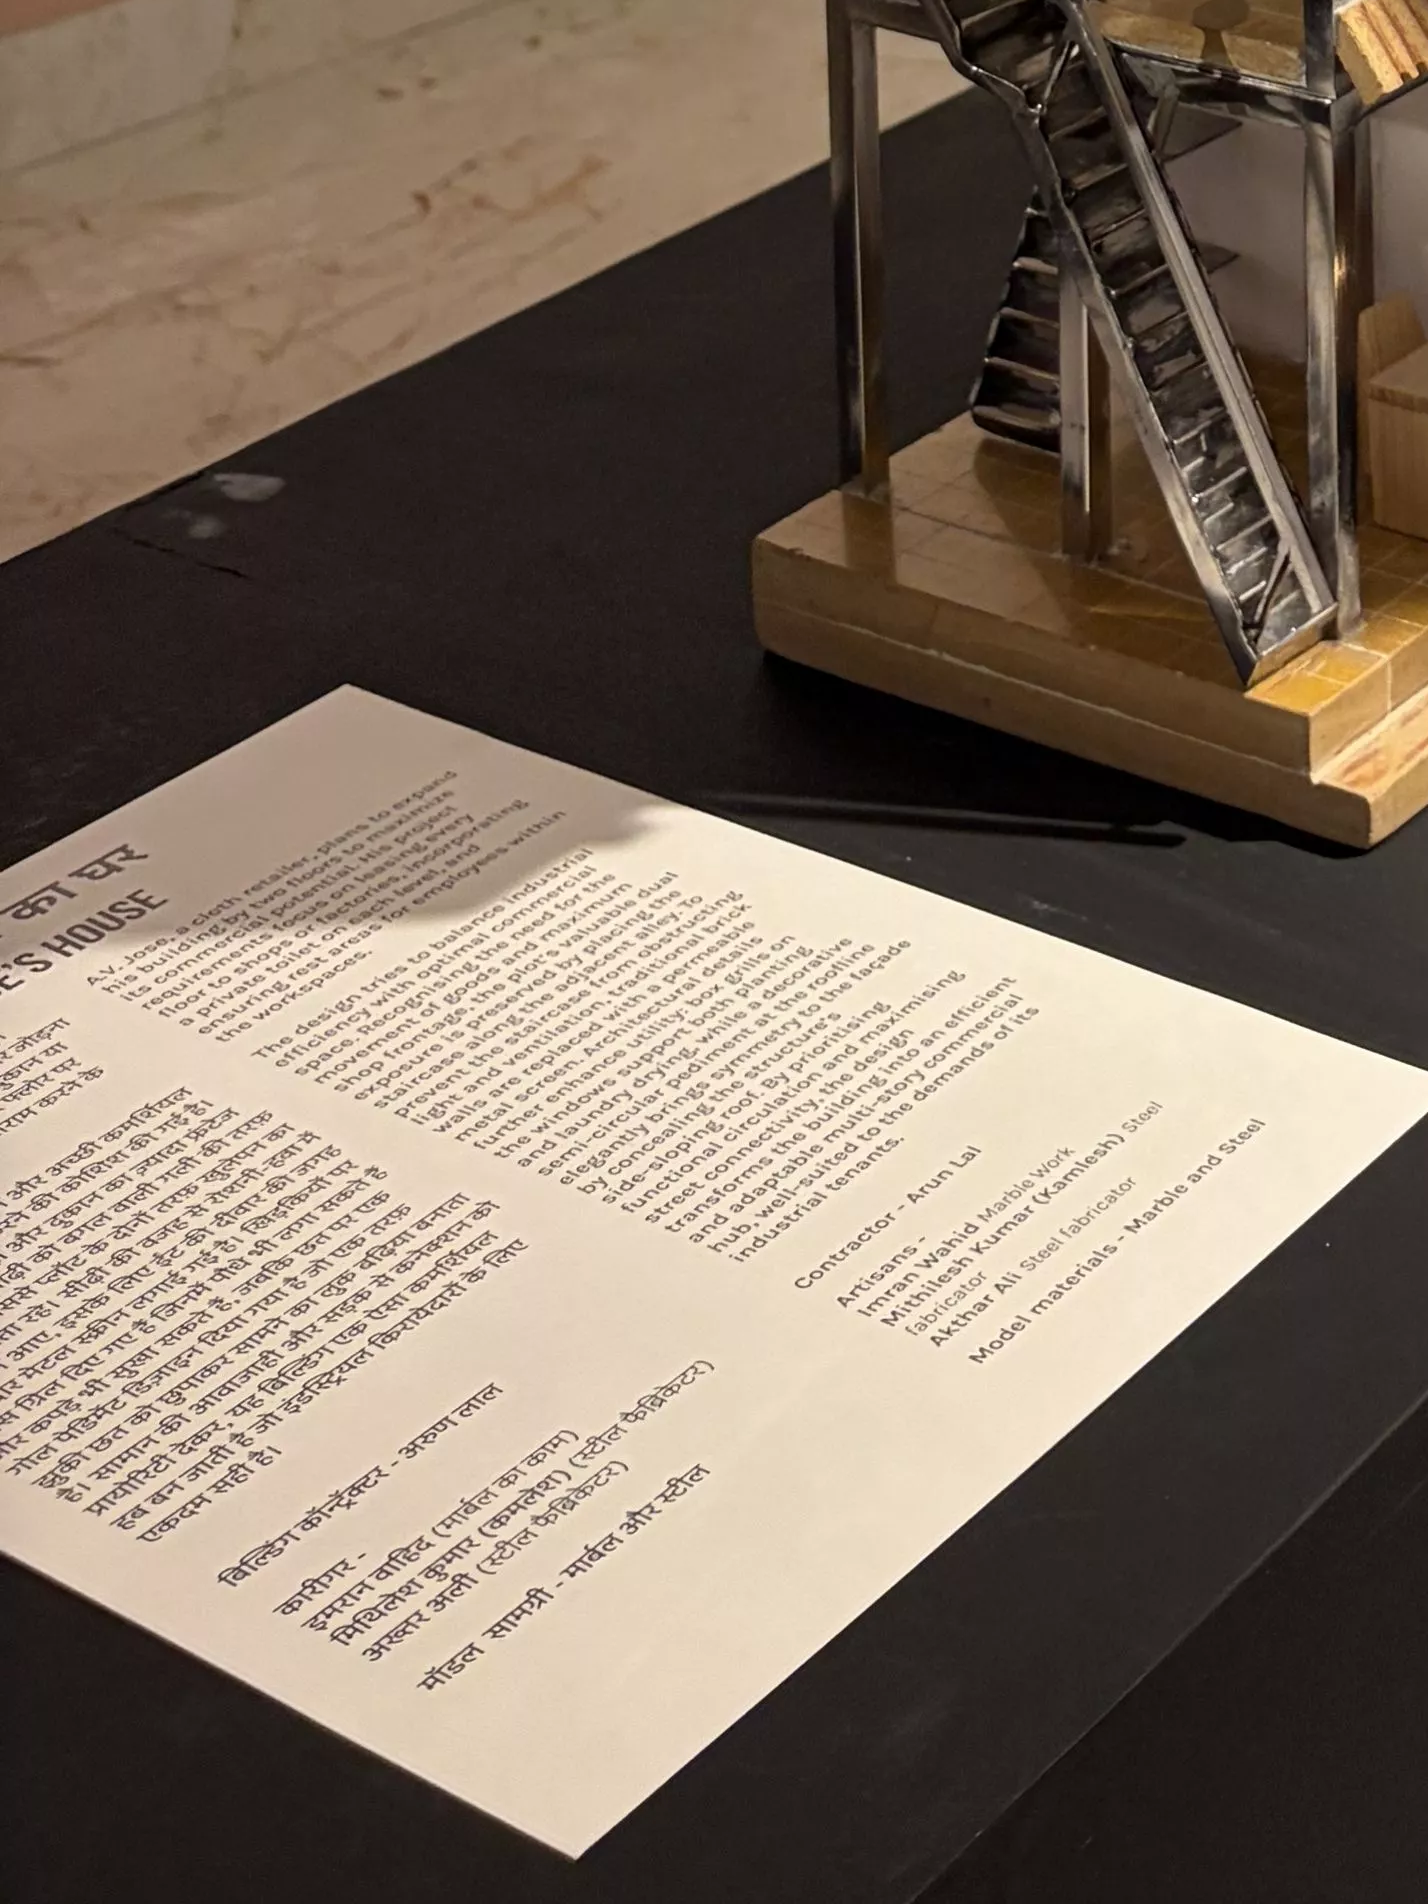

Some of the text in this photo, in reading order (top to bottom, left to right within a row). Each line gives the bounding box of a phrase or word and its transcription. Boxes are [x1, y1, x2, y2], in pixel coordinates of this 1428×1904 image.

[40, 888, 169, 958] HOUSE
[67, 843, 149, 881] घर
[249, 847, 593, 1058] The design tries to balance industrial
[559, 939, 911, 1185] elegantly brings symmetry to the façade
[575, 1011, 841, 1195] by concealing the structure's
[601, 1000, 891, 1204] side-sloping roof. By prioritising
[619, 969, 966, 1213] functional circulation and maximising
[644, 1028, 915, 1224] street connectivity, the design
[663, 976, 1017, 1233] transforms the building into an efficient
[687, 992, 1023, 1244] and adaptable multi-story commercial
[705, 1006, 1040, 1253] hub, well-suited to the demands of its
[727, 1136, 905, 1262] industrial tenants.
[793, 1211, 896, 1289] Contractor
[905, 1168, 954, 1204] Arun
[947, 1144, 982, 1168] Lal
[836, 1244, 918, 1308] Artisans
[855, 1146, 1076, 1317] Imran Wahid Marble Work
[879, 1099, 1163, 1327] Mithilesh Kumar (Kamlesh) Steel
[929, 1176, 1136, 1348] Akthar Ali Steel fabricator
[967, 1314, 1032, 1364] Model
[1029, 1243, 1118, 1315] materials
[1122, 1183, 1189, 1234] Marble
[1185, 1153, 1223, 1184] and
[1217, 1117, 1266, 1155] Steel
[903, 1270, 987, 1336] fabricator
